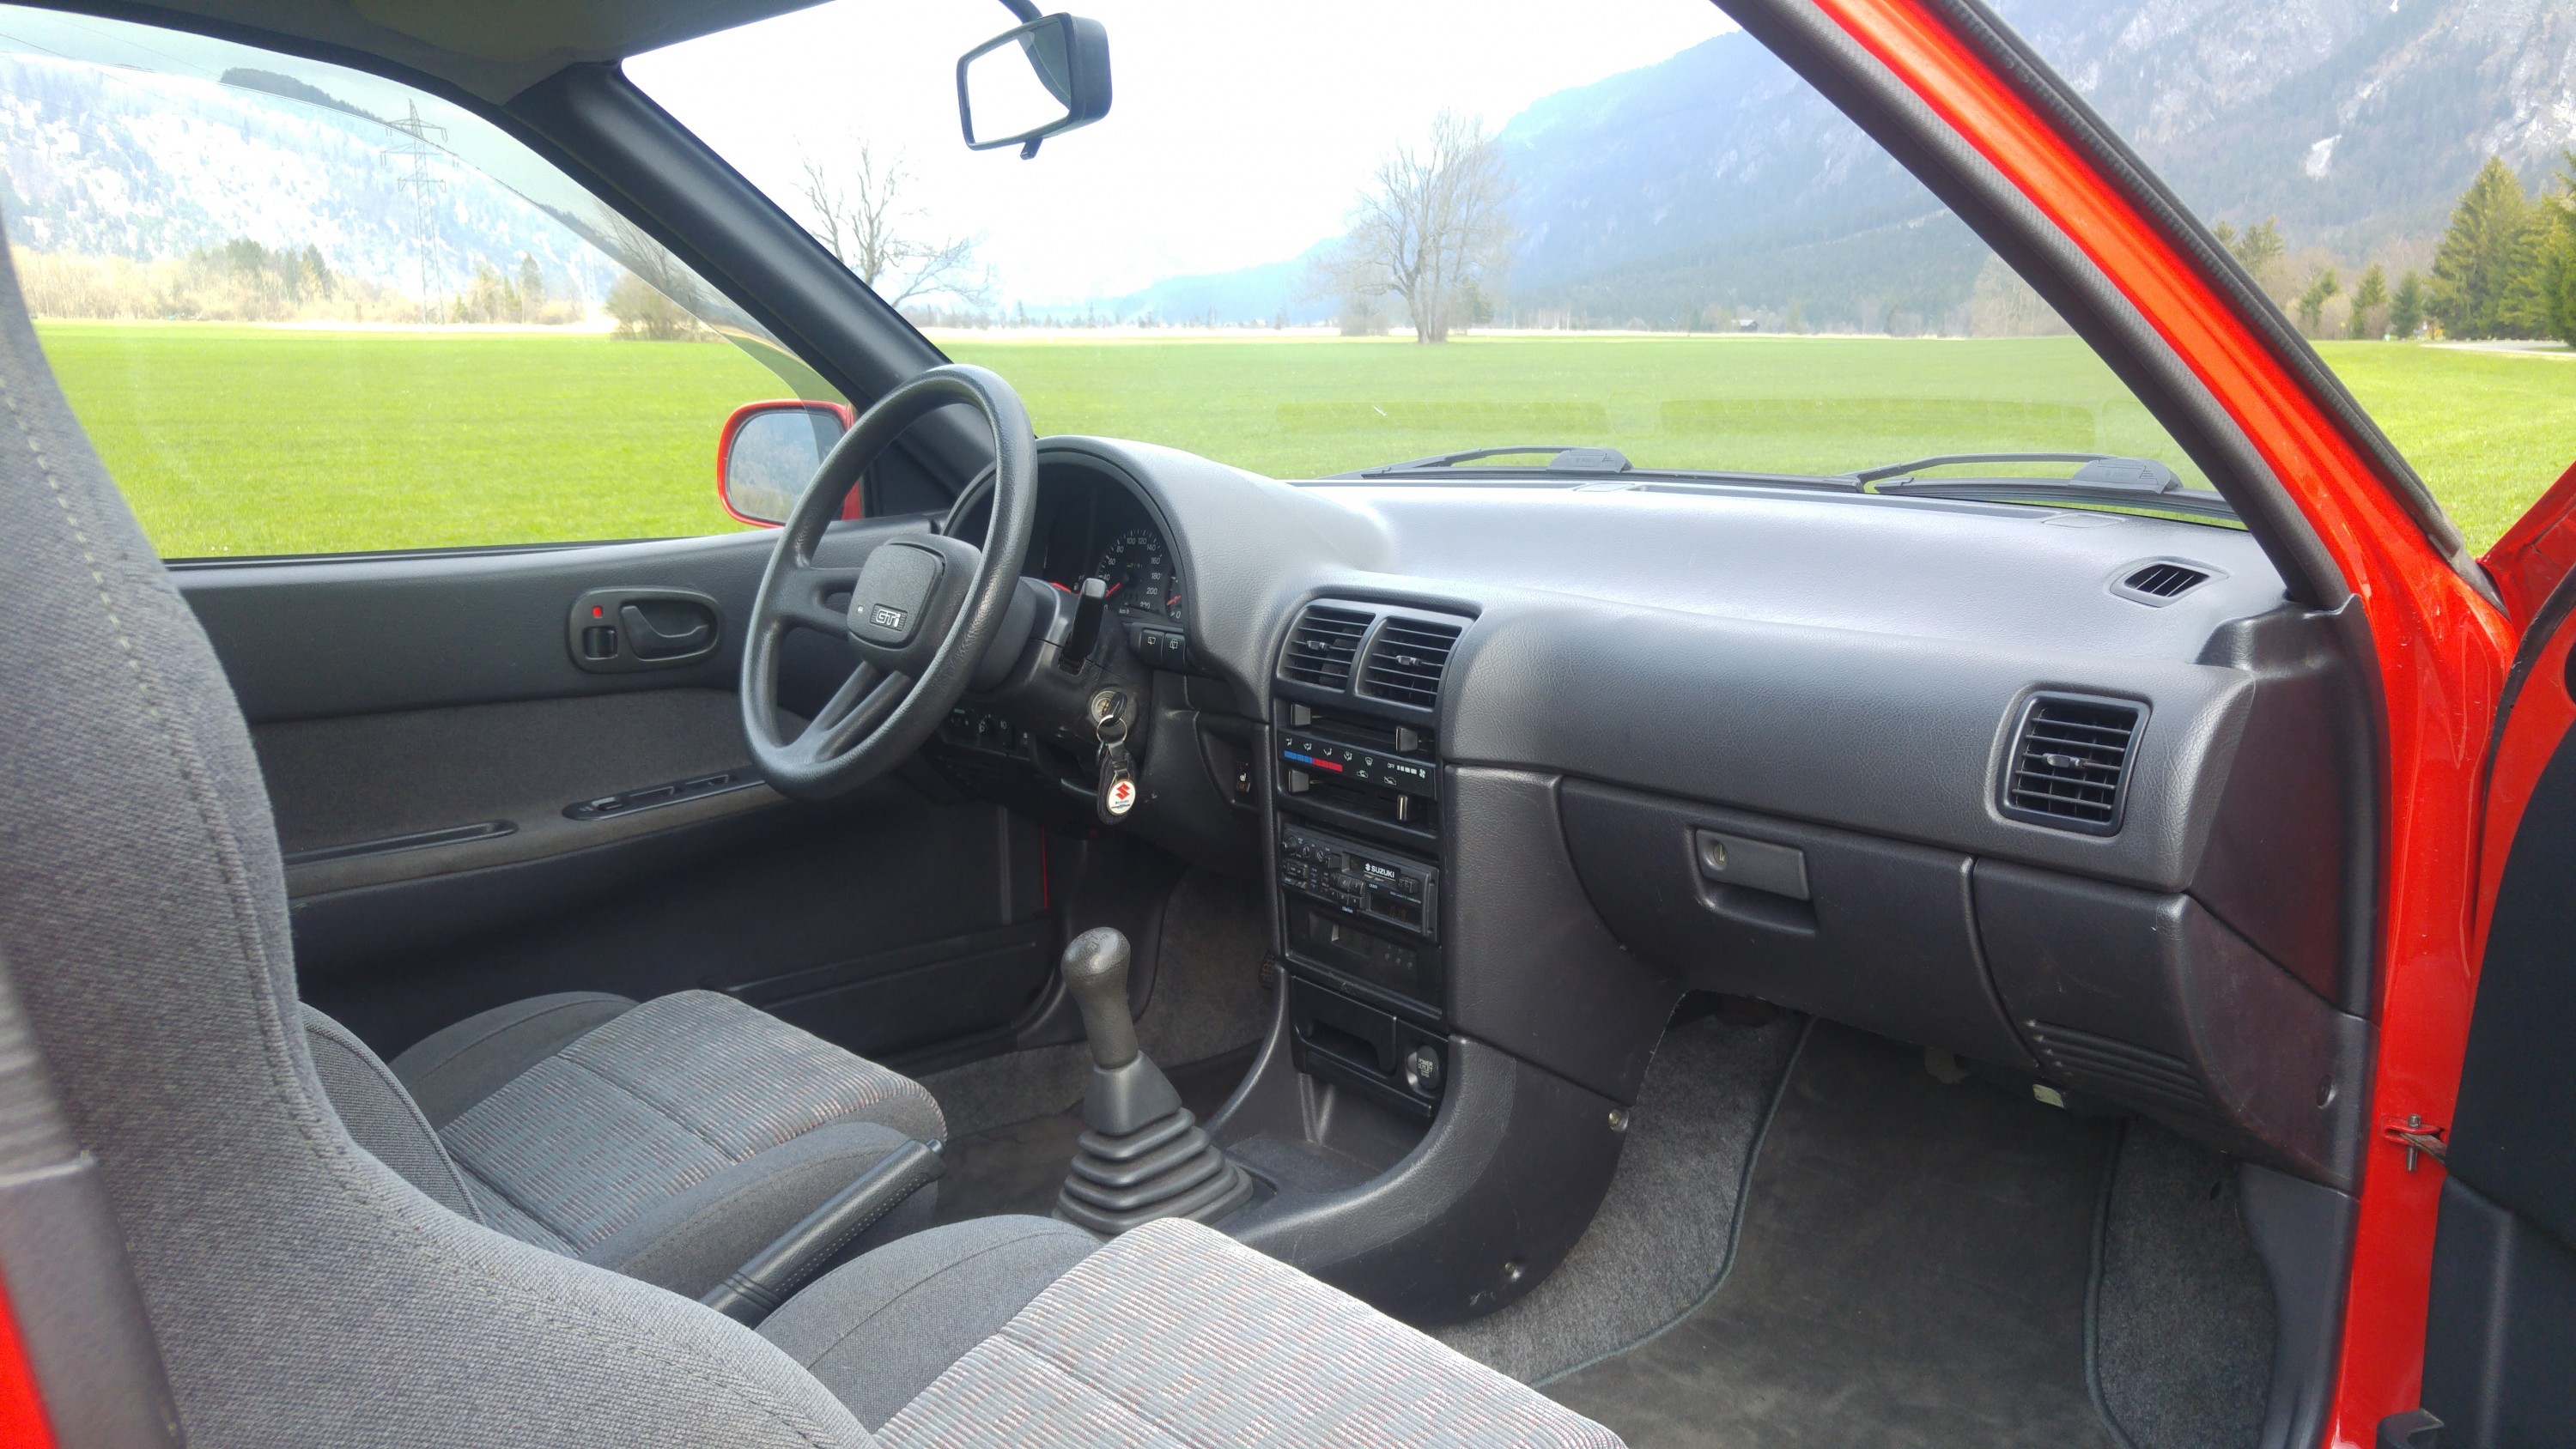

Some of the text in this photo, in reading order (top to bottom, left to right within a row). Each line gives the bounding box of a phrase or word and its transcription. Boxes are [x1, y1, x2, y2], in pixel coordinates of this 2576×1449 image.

[876, 609, 901, 627] GTi
[1371, 865, 1395, 878] SUZUKI
[1418, 1058, 1433, 1067] POWER
